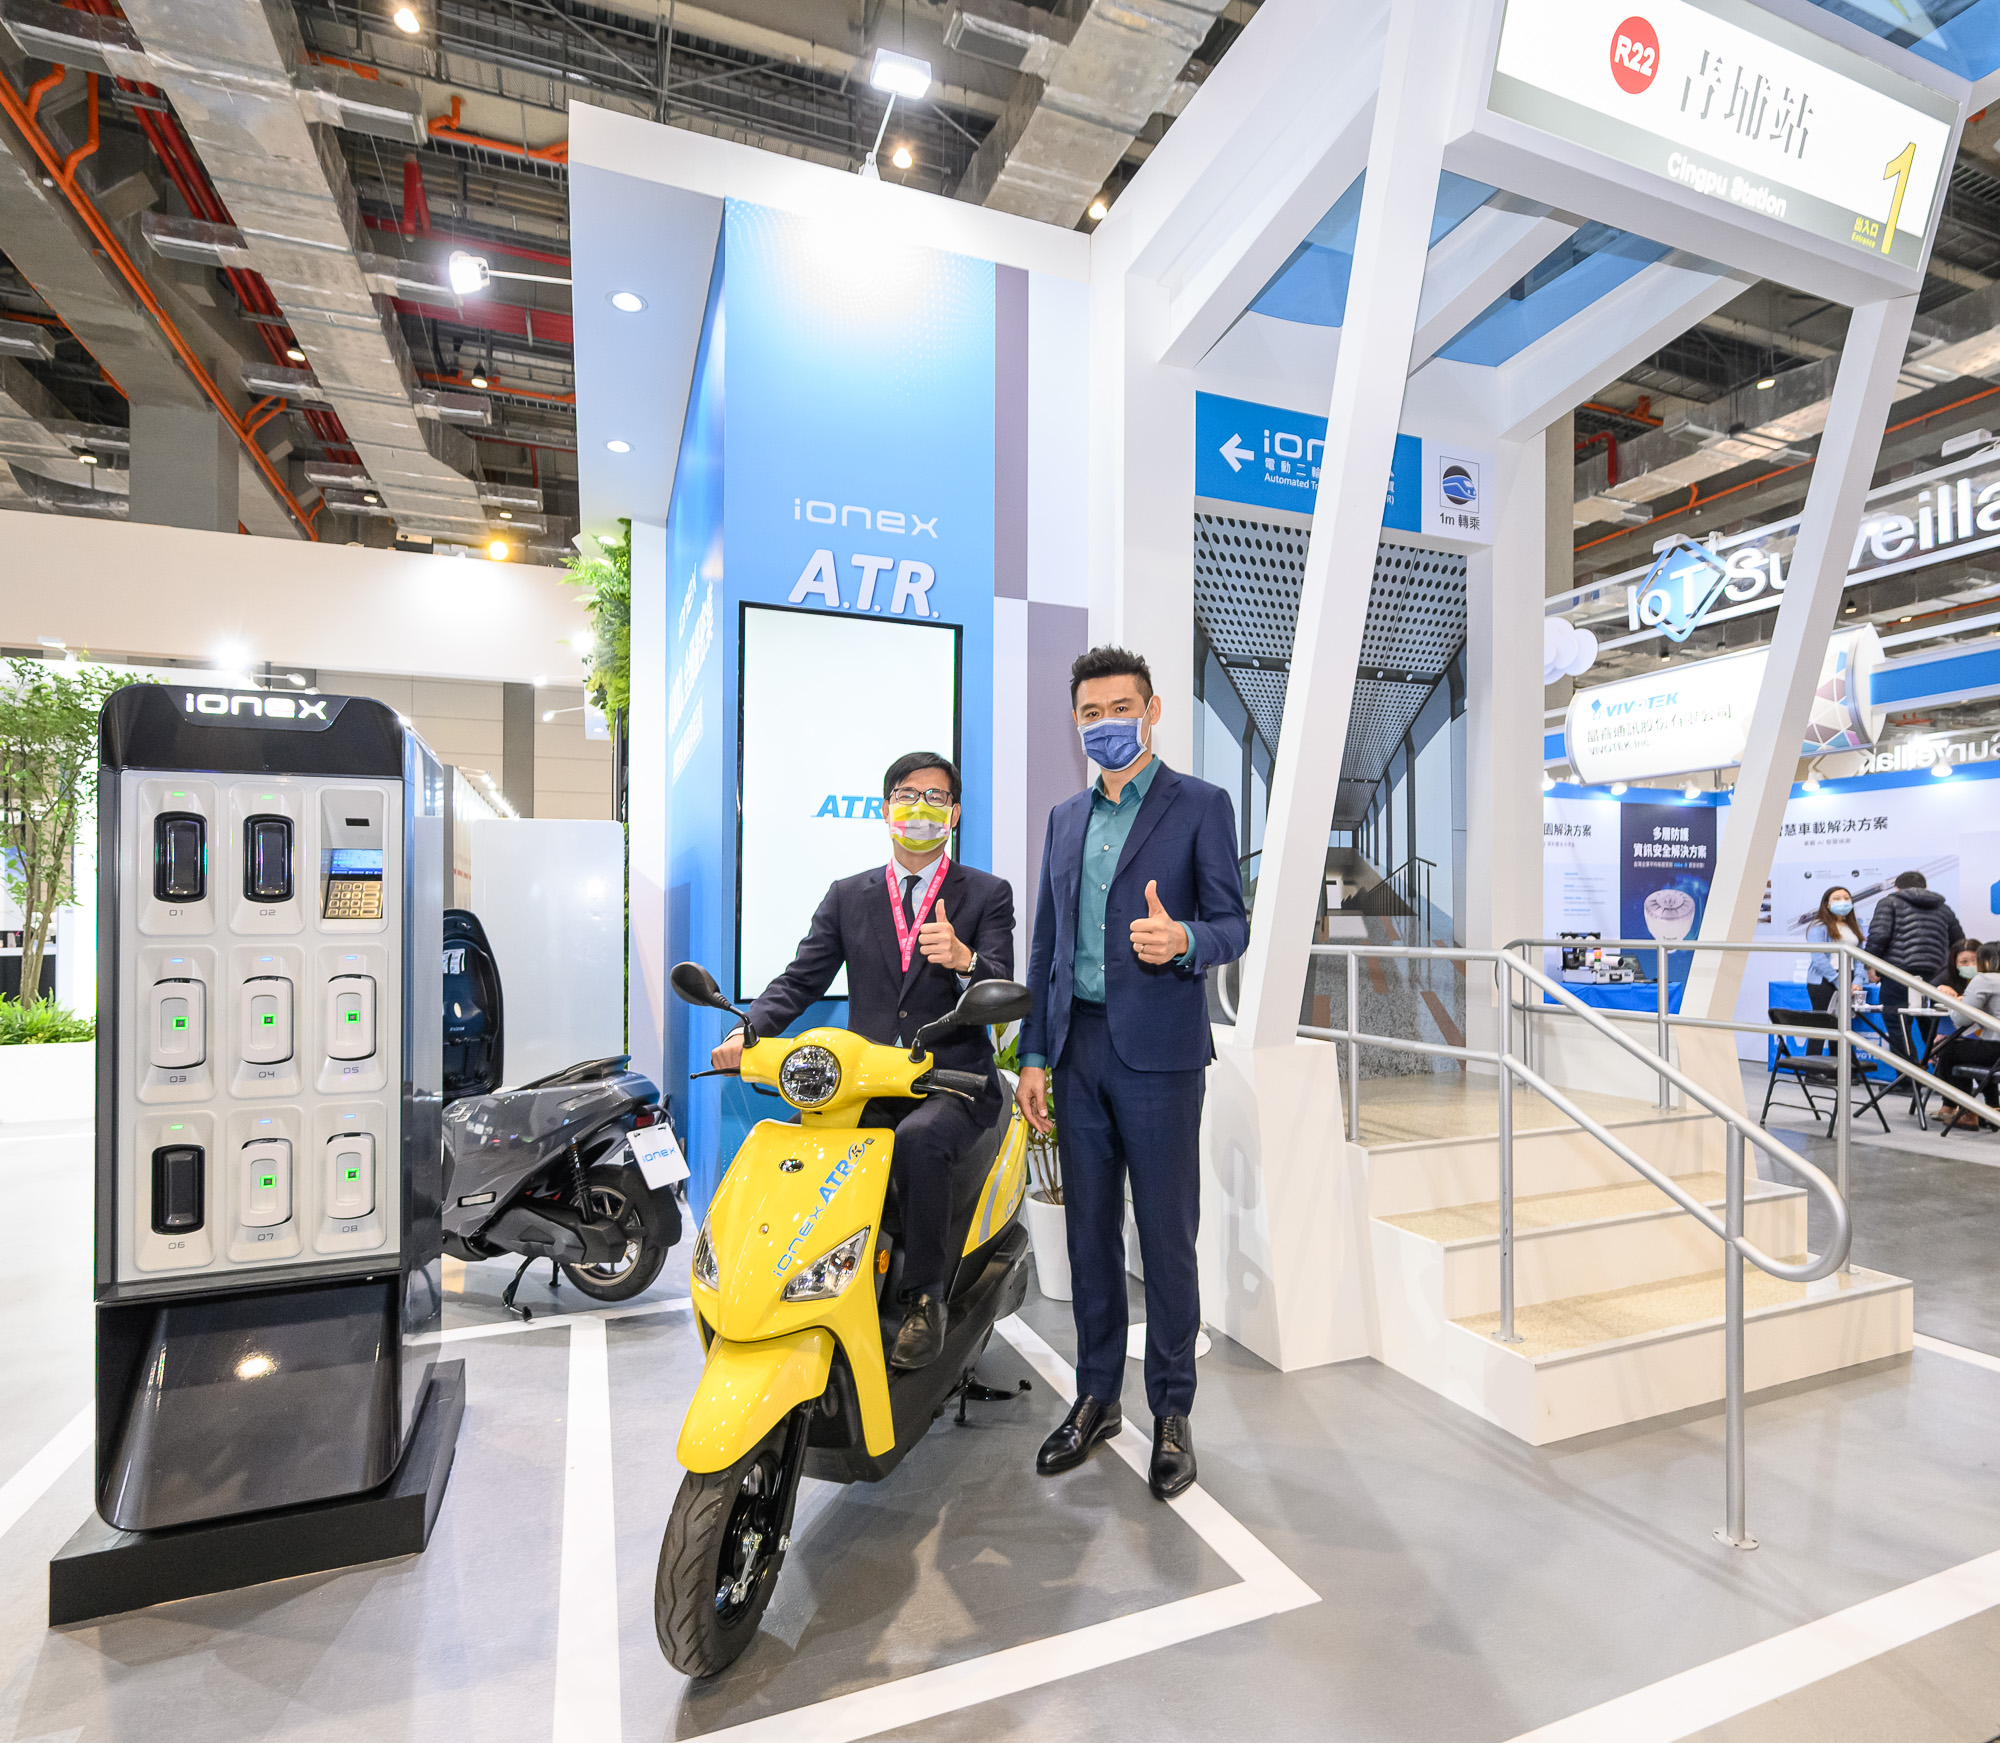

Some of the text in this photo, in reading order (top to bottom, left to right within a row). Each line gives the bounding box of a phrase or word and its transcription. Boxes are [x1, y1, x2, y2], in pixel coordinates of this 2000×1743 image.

[1614, 34, 1655, 77] R22
[1730, 176, 1787, 218] Station
[1883, 142, 1916, 255] 1
[1854, 216, 1879, 238] 出入口
[1264, 473, 1309, 489] Automated
[1310, 480, 1320, 490] Tr
[795, 498, 938, 539] ionex
[1440, 512, 1455, 525] 1m
[788, 549, 940, 618] A.T.R.
[186, 693, 327, 720] ionex
[815, 795, 884, 819] ATR
[1633, 843, 1707, 859] 資訊安全解決方案
[169, 909, 184, 917] 01
[259, 909, 276, 917] 02
[258, 1070, 276, 1079] 04
[343, 1066, 359, 1074] 05
[169, 1074, 187, 1083] 03
[641, 1147, 677, 1163] ionex
[773, 1159, 851, 1277] ionex ATR
[257, 1233, 274, 1241] 07
[342, 1225, 358, 1233] 08
[168, 1241, 185, 1250] 06
